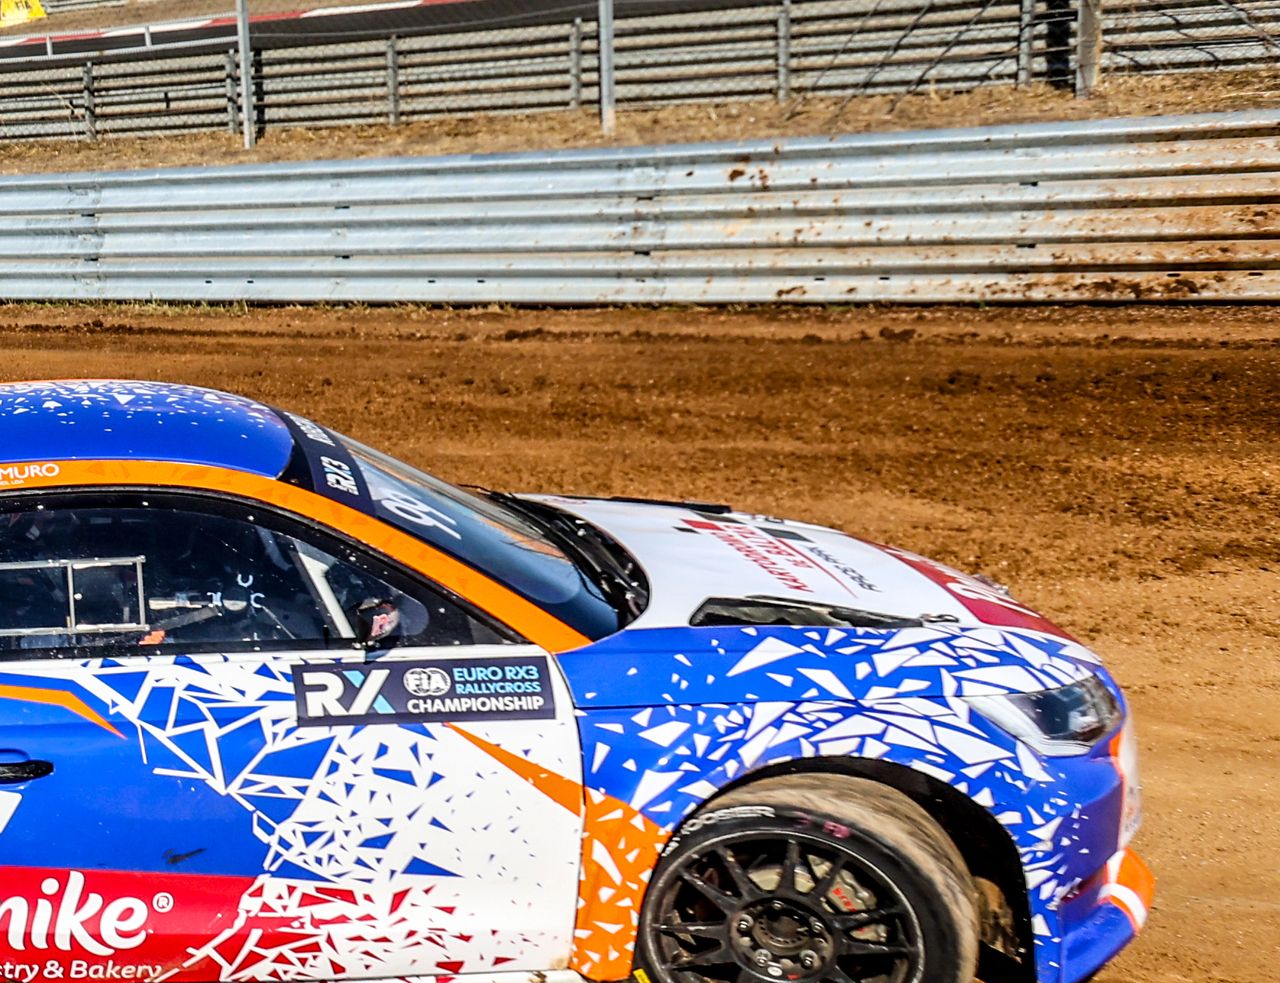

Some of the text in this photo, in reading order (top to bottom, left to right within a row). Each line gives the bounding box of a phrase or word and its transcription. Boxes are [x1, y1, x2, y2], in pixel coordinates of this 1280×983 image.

[452, 665, 540, 683] EURO RX3
[302, 668, 397, 717] RX
[455, 681, 542, 694] RALLYCROSS
[406, 696, 545, 714] CHAMPIONSHIP
[43, 960, 65, 979] &
[69, 959, 164, 983] Bakery
